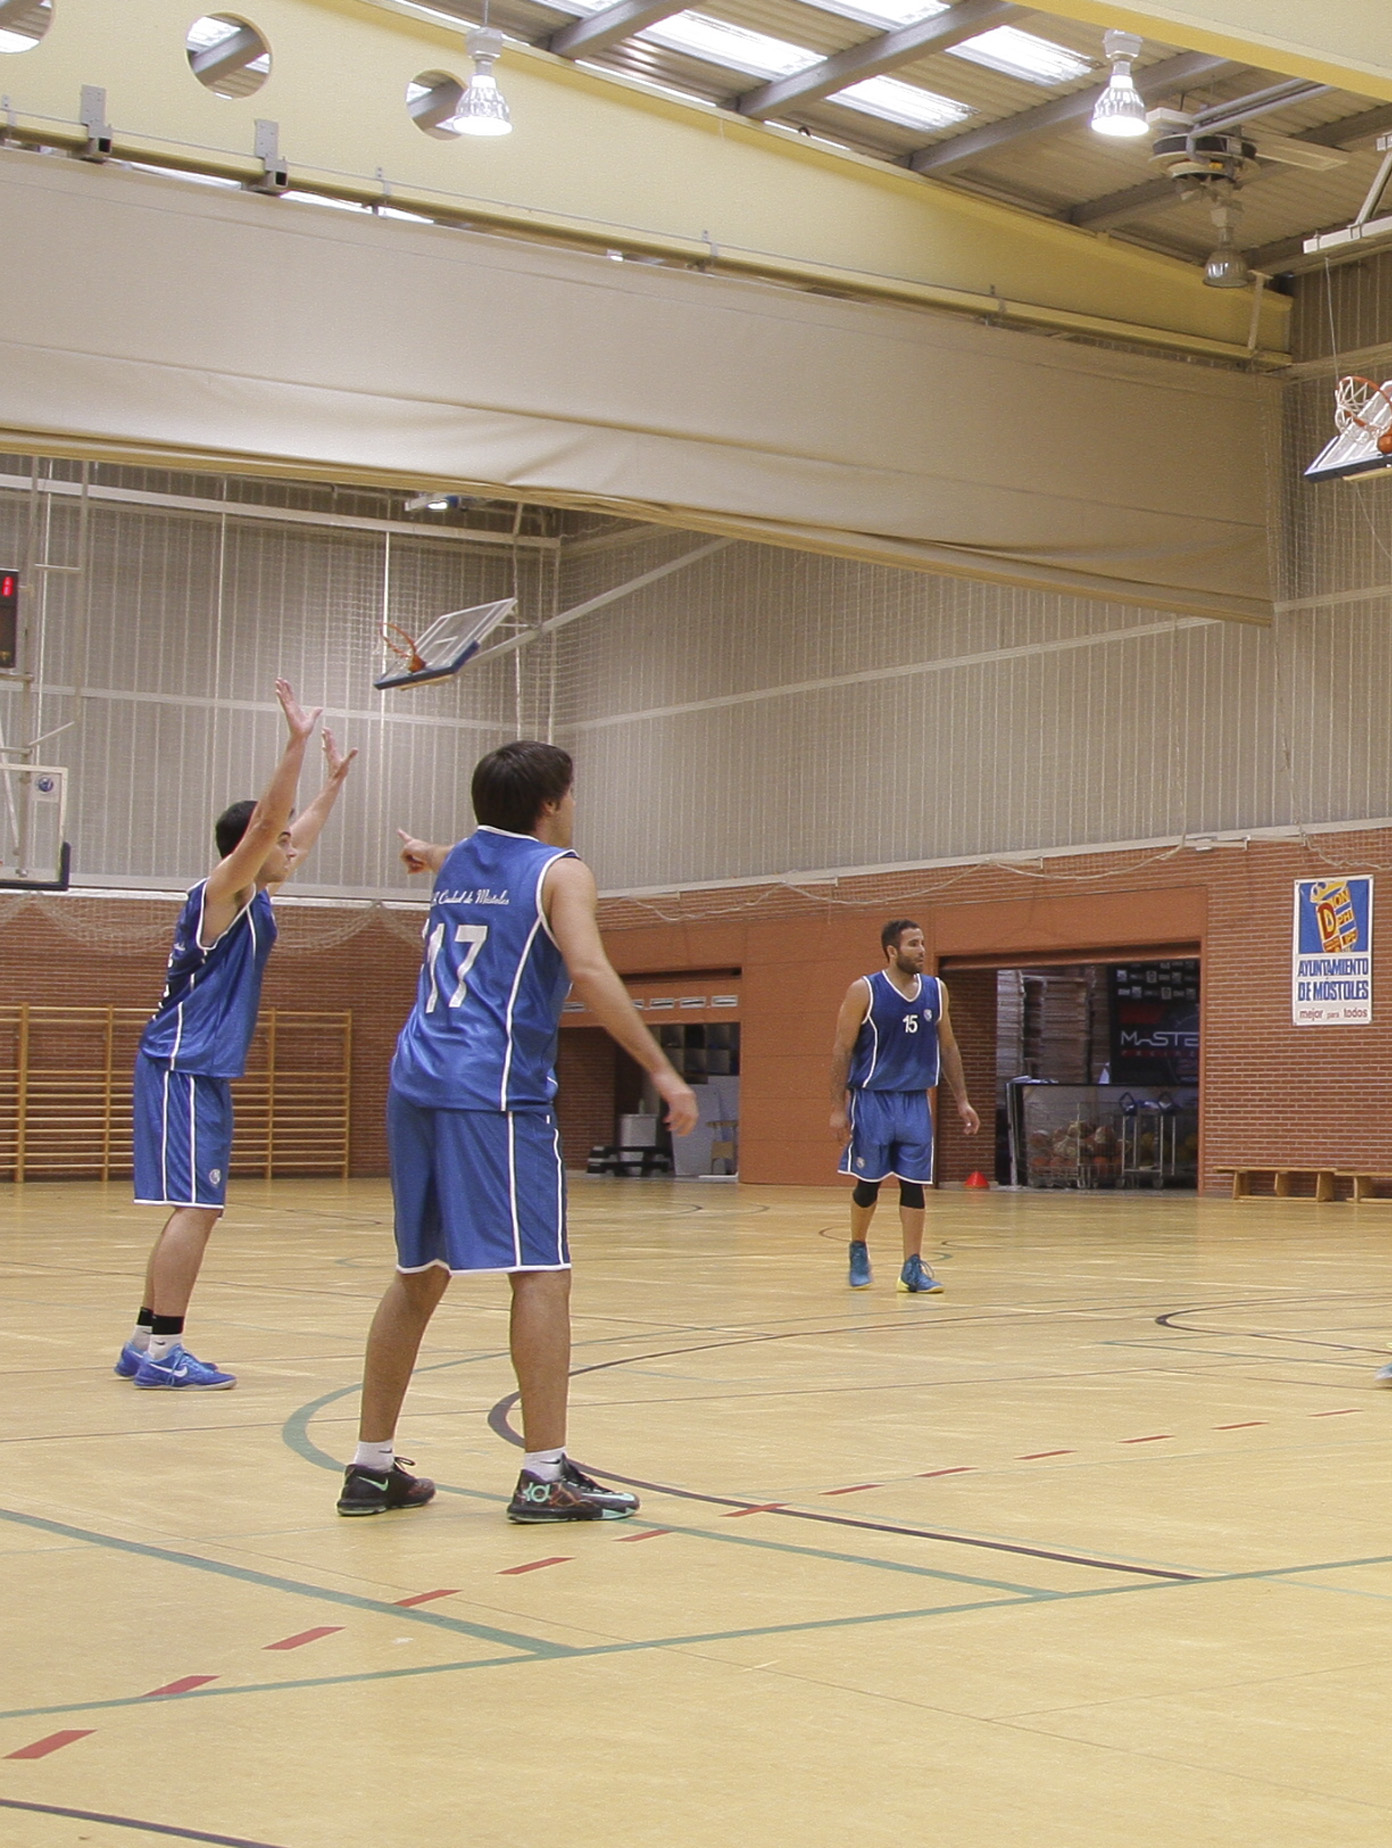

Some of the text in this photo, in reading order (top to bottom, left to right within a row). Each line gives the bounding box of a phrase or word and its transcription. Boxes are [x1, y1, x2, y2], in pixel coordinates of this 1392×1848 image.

[1298, 958, 1369, 977] AYUNTAMIENTO
[1298, 977, 1369, 1001] DE MÓSTOLES
[902, 1014, 918, 1033] 15
[1300, 1008, 1323, 1021] mejor
[1343, 1007, 1368, 1018] todos
